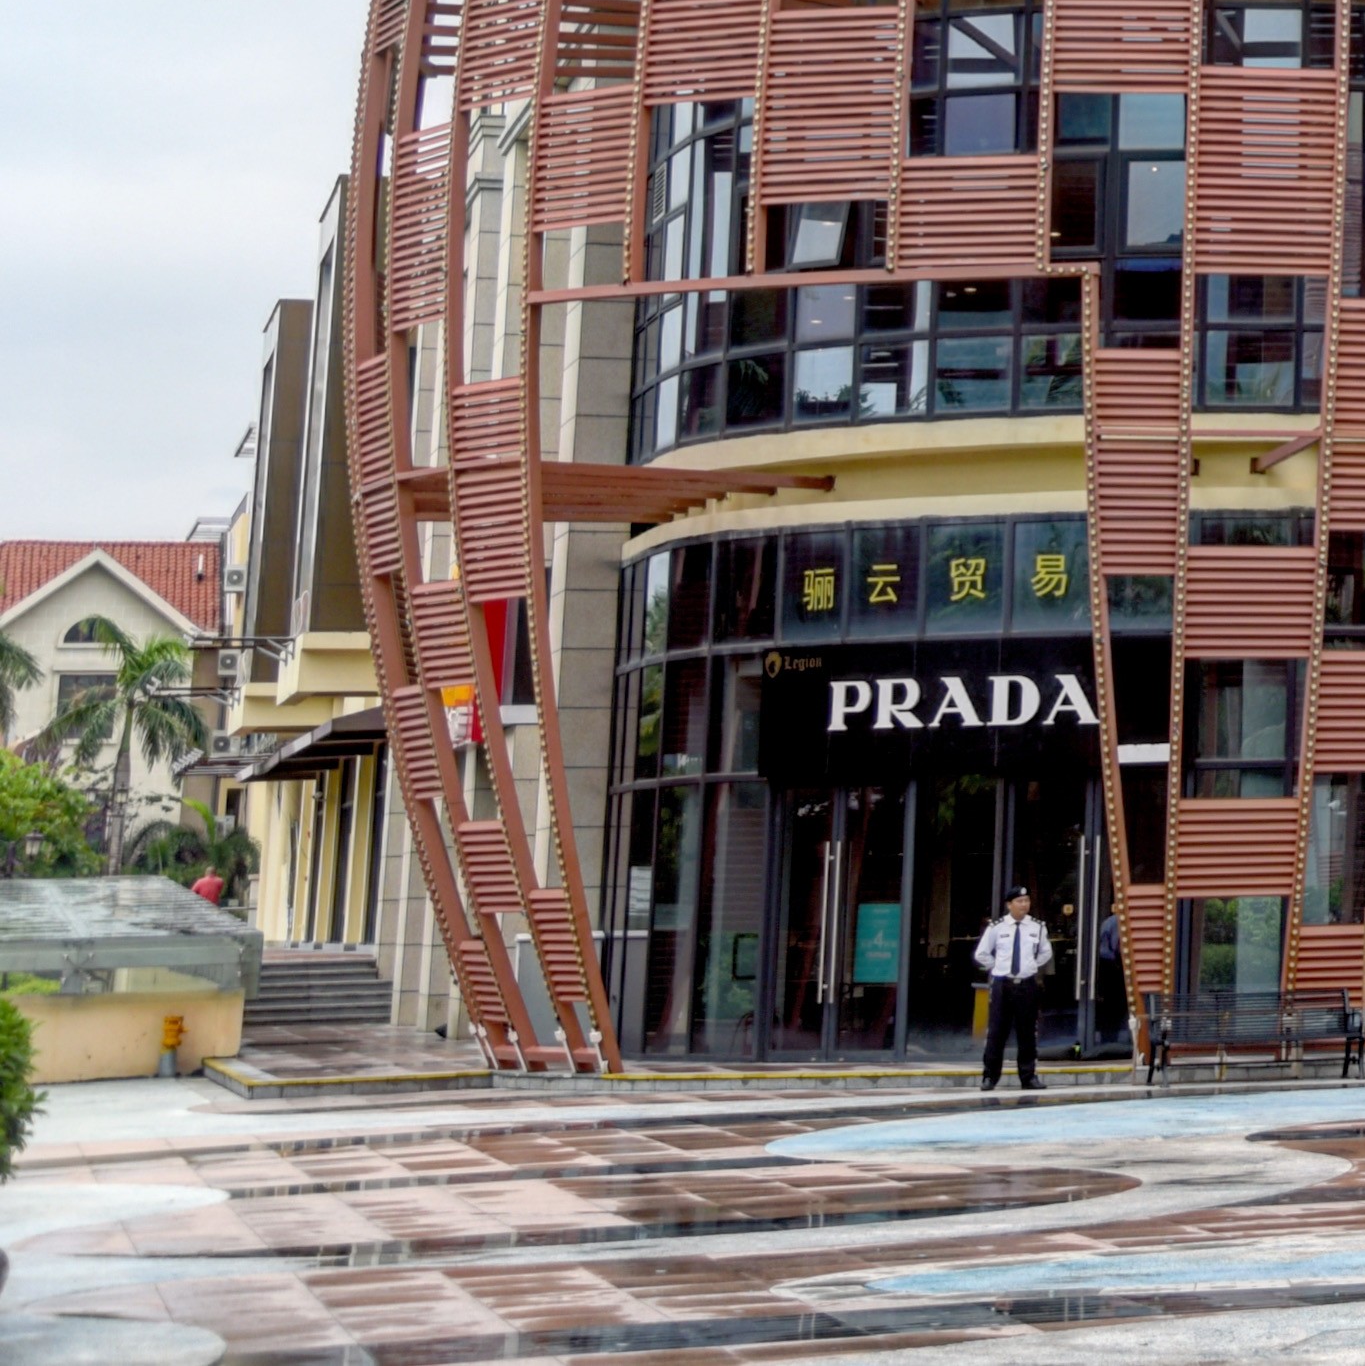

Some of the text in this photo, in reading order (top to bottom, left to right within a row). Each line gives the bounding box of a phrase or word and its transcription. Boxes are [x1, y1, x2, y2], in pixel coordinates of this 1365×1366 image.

[802, 553, 1068, 612] 骊云贸易
[784, 655, 822, 672] Legion
[827, 674, 1100, 732] PRADA
